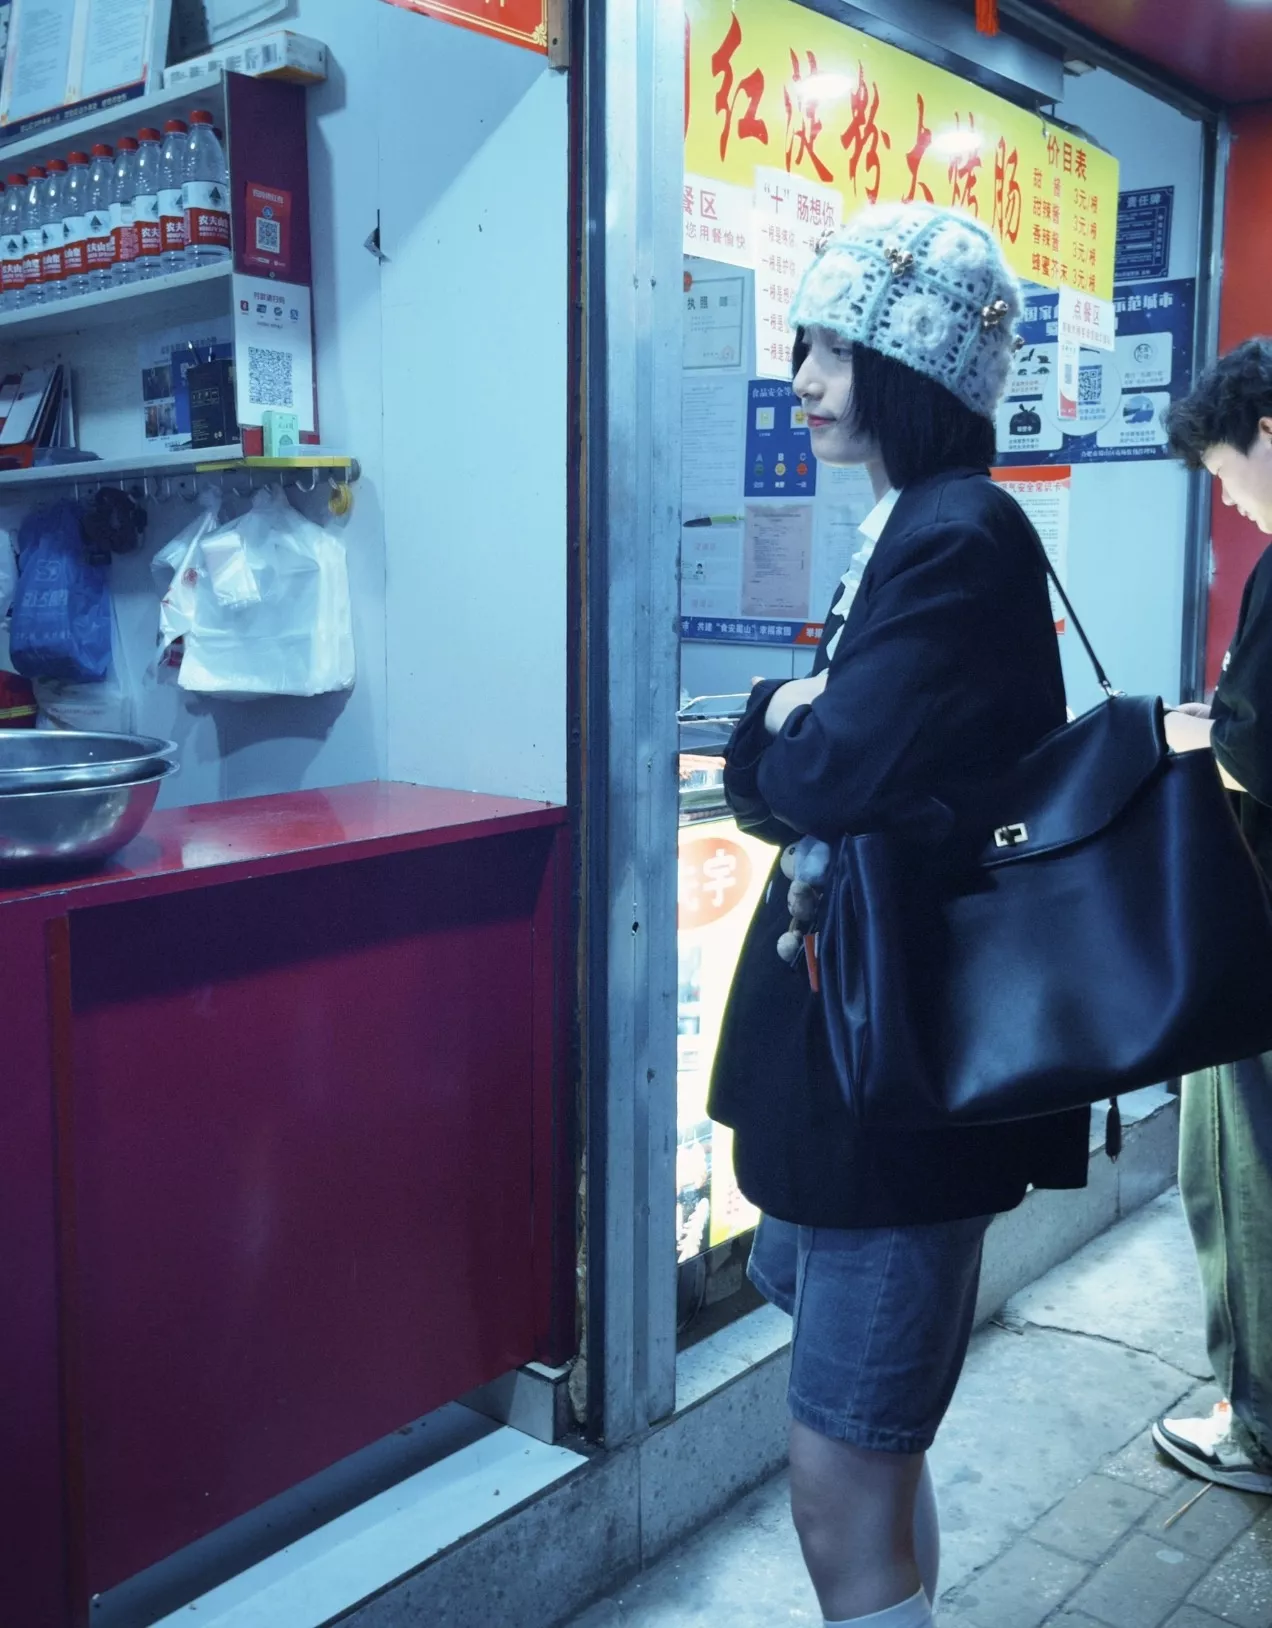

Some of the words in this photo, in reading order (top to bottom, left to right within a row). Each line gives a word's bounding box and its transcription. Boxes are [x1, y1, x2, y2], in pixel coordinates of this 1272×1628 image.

[1047, 134, 1087, 181] 价目表
[752, 387, 796, 399] 食品安全等
[756, 453, 763, 462] A
[778, 453, 784, 462] B
[800, 453, 806, 462] C
